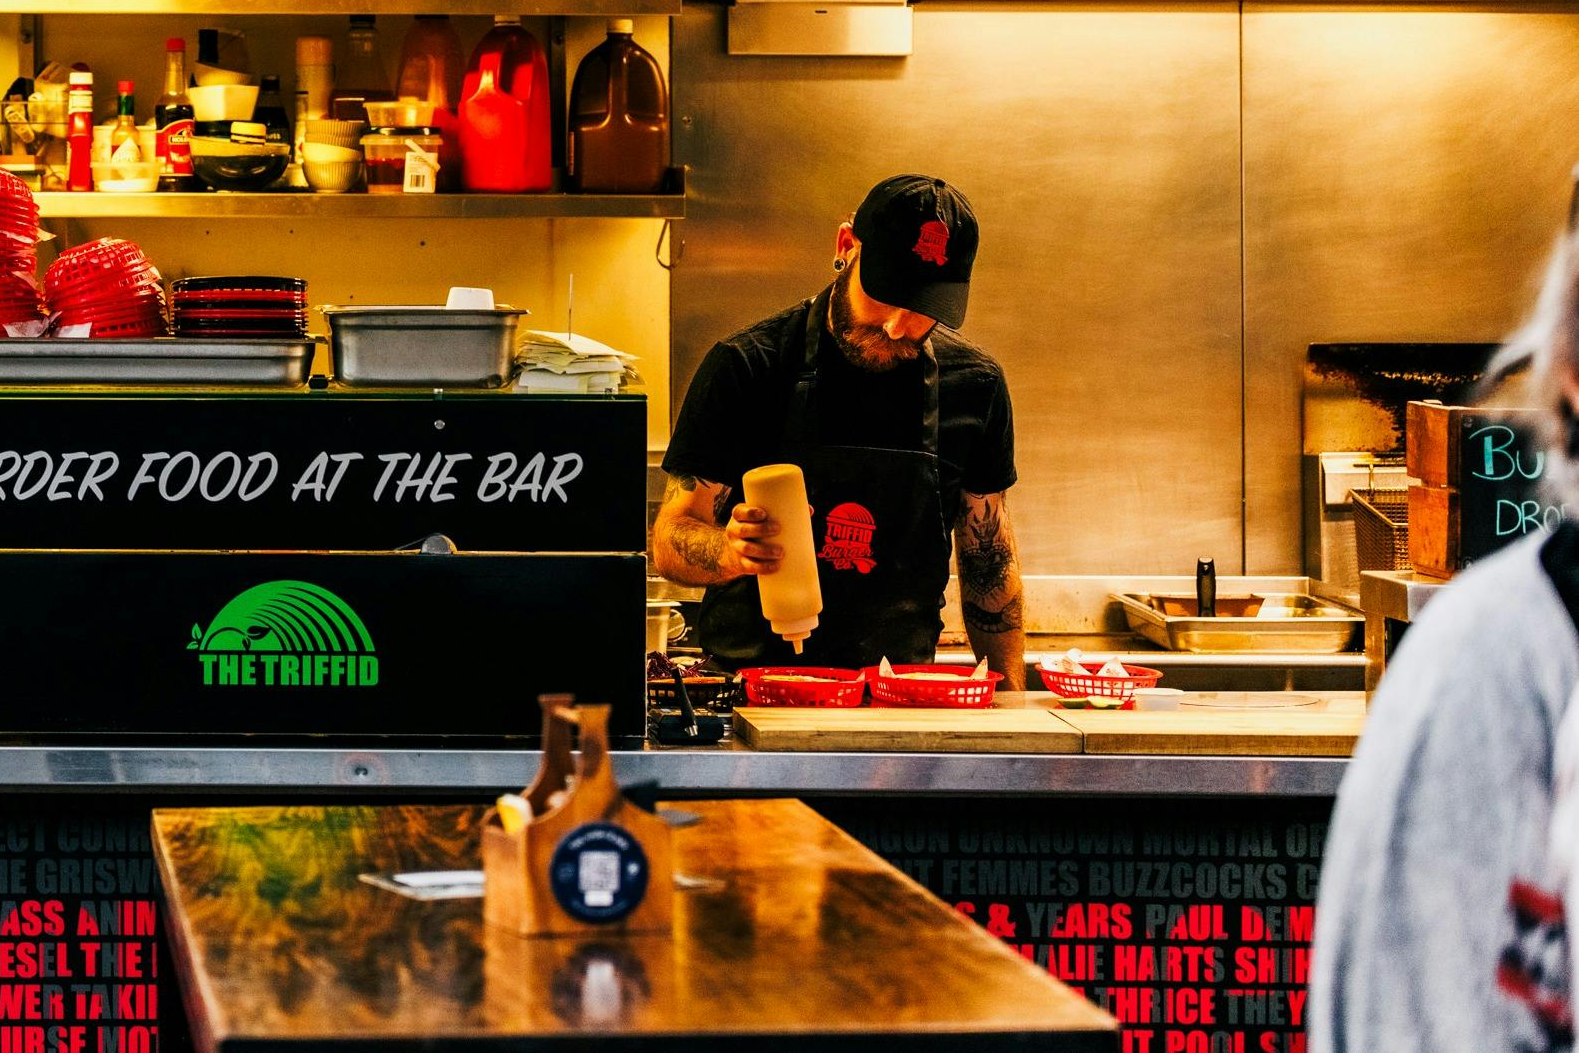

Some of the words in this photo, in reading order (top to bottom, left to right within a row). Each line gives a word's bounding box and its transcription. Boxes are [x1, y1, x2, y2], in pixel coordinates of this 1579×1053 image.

[128, 451, 278, 501] FOOD
[292, 452, 363, 501] AT
[374, 452, 460, 502] THE
[477, 452, 583, 502] BAR
[827, 523, 873, 543] TRIFFID
[818, 544, 873, 558] Burger
[200, 656, 257, 686] THE
[262, 656, 379, 686] TRIFFID
[944, 862, 1079, 897] FEMMES
[1089, 862, 1287, 897] BUZZCOCKS
[1027, 904, 1132, 939] YEARS
[1146, 904, 1228, 939] PAUL
[79, 943, 142, 979] THE
[1114, 946, 1222, 981] HARTS
